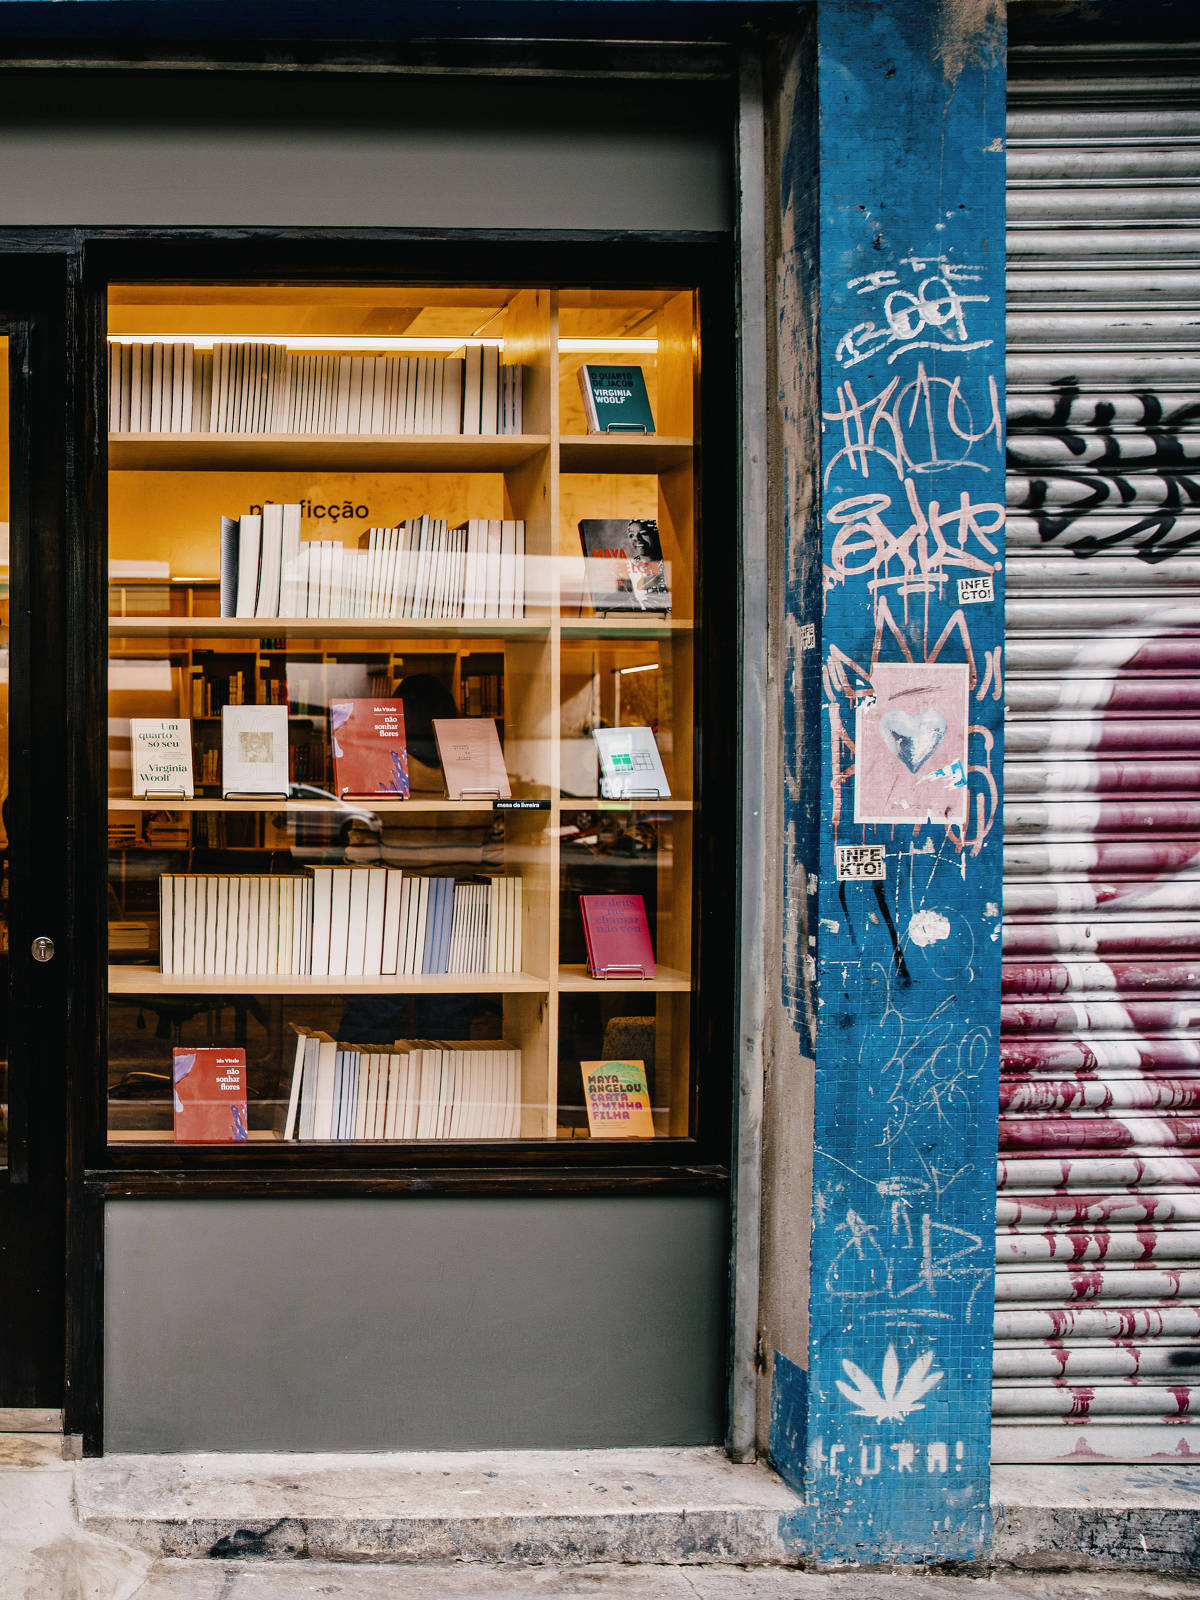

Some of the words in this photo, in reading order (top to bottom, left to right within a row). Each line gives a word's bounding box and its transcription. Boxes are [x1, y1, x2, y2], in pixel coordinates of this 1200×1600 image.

[593, 388, 632, 397] VIRGINIA
[595, 396, 626, 404] WOOLF
[299, 499, 369, 523] ficção
[592, 548, 628, 560] MAYA
[960, 578, 990, 591] INFE
[960, 589, 991, 601] CTO!
[138, 733, 173, 741] quarto
[149, 764, 188, 773] Virginia
[140, 773, 171, 781] Woolf
[840, 849, 881, 862] INFE
[840, 862, 882, 876] KTO!
[607, 897, 636, 907] deus
[595, 915, 639, 924] chamar
[596, 925, 618, 933] não
[215, 1075, 240, 1083] sonhar
[587, 1075, 619, 1084] MAYA
[589, 1083, 642, 1093] ANGELOU
[590, 1093, 629, 1102] CARTA
[602, 1101, 643, 1110] MINHA
[592, 1111, 631, 1120] FILHA
[829, 1440, 964, 1476] CURA!
